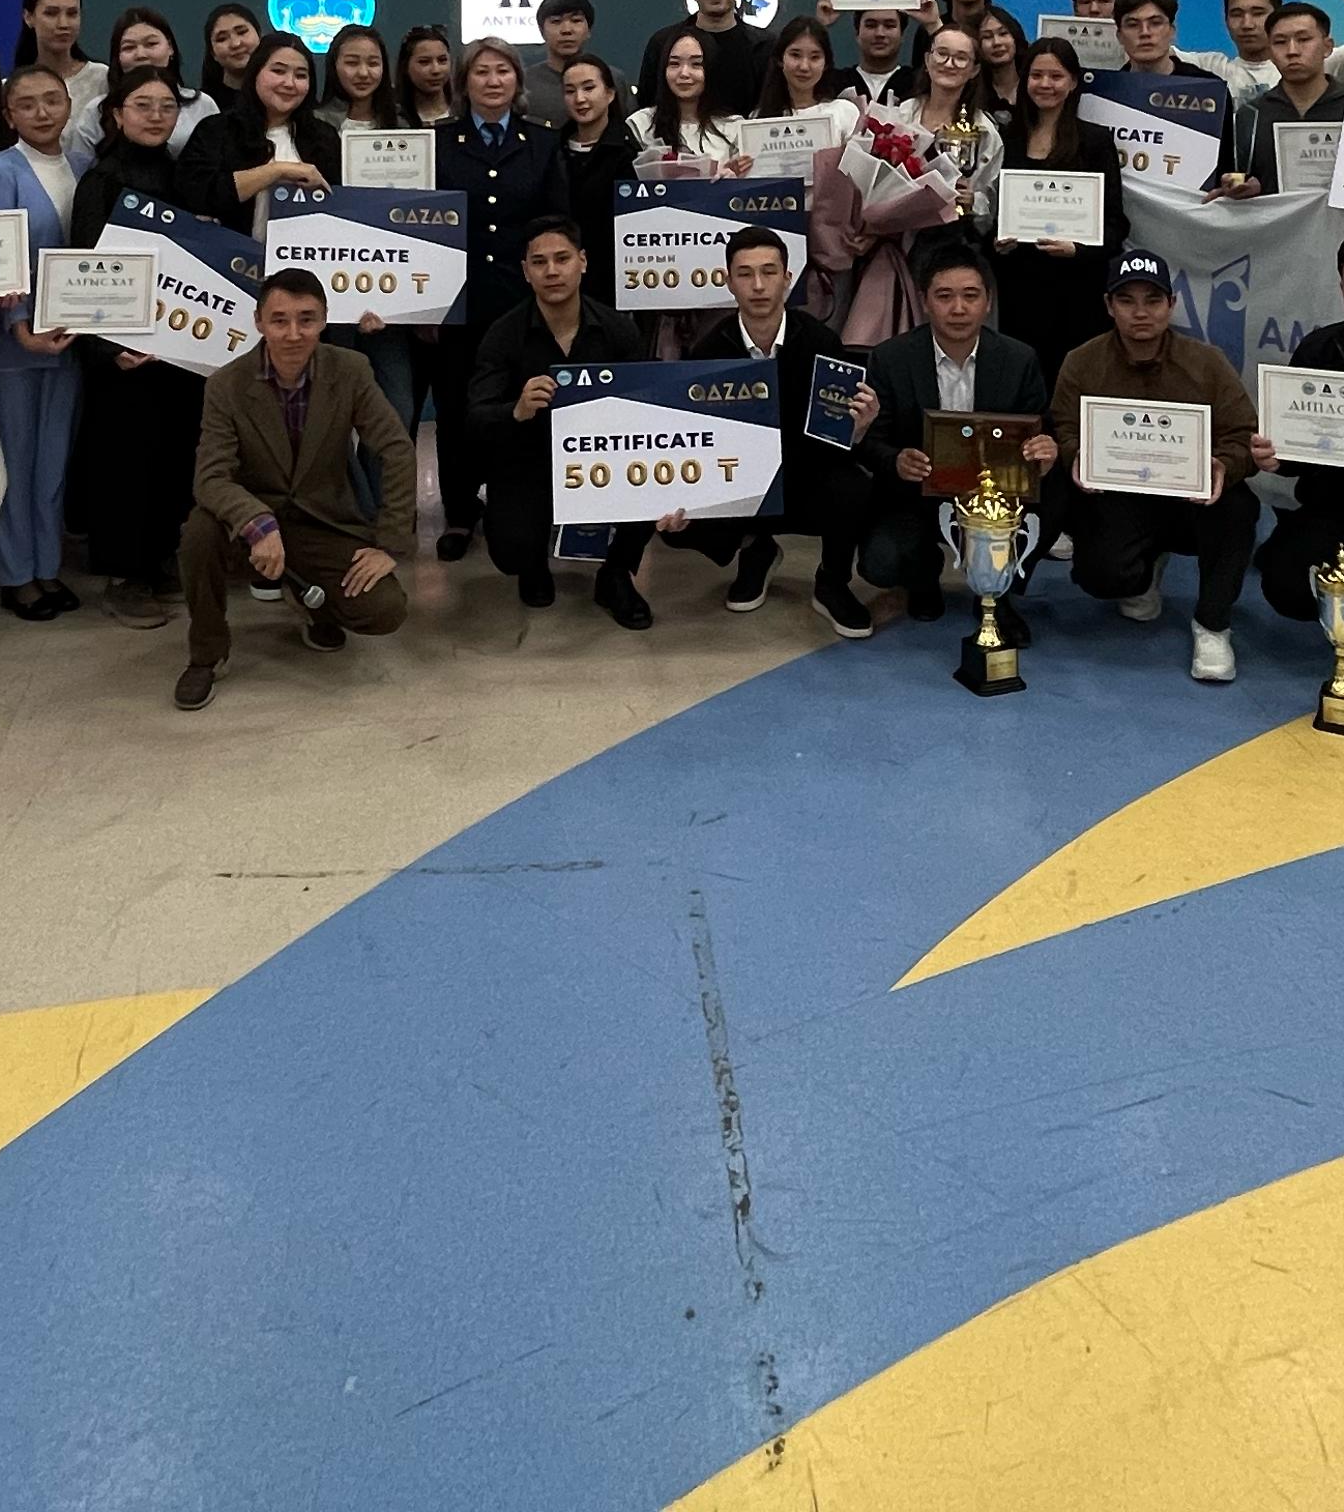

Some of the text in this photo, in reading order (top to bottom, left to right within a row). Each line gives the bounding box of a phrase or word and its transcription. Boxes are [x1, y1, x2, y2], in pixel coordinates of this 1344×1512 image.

[1118, 148, 1150, 172] 00
[276, 246, 410, 263] CERTIFICATE
[1119, 257, 1158, 275] АФМ
[330, 270, 398, 294] 000
[624, 267, 727, 289] 300 00
[157, 273, 236, 316] IFICATE
[562, 431, 715, 453] CERTIFICATE
[564, 462, 611, 489] 50
[626, 458, 702, 487] 000
